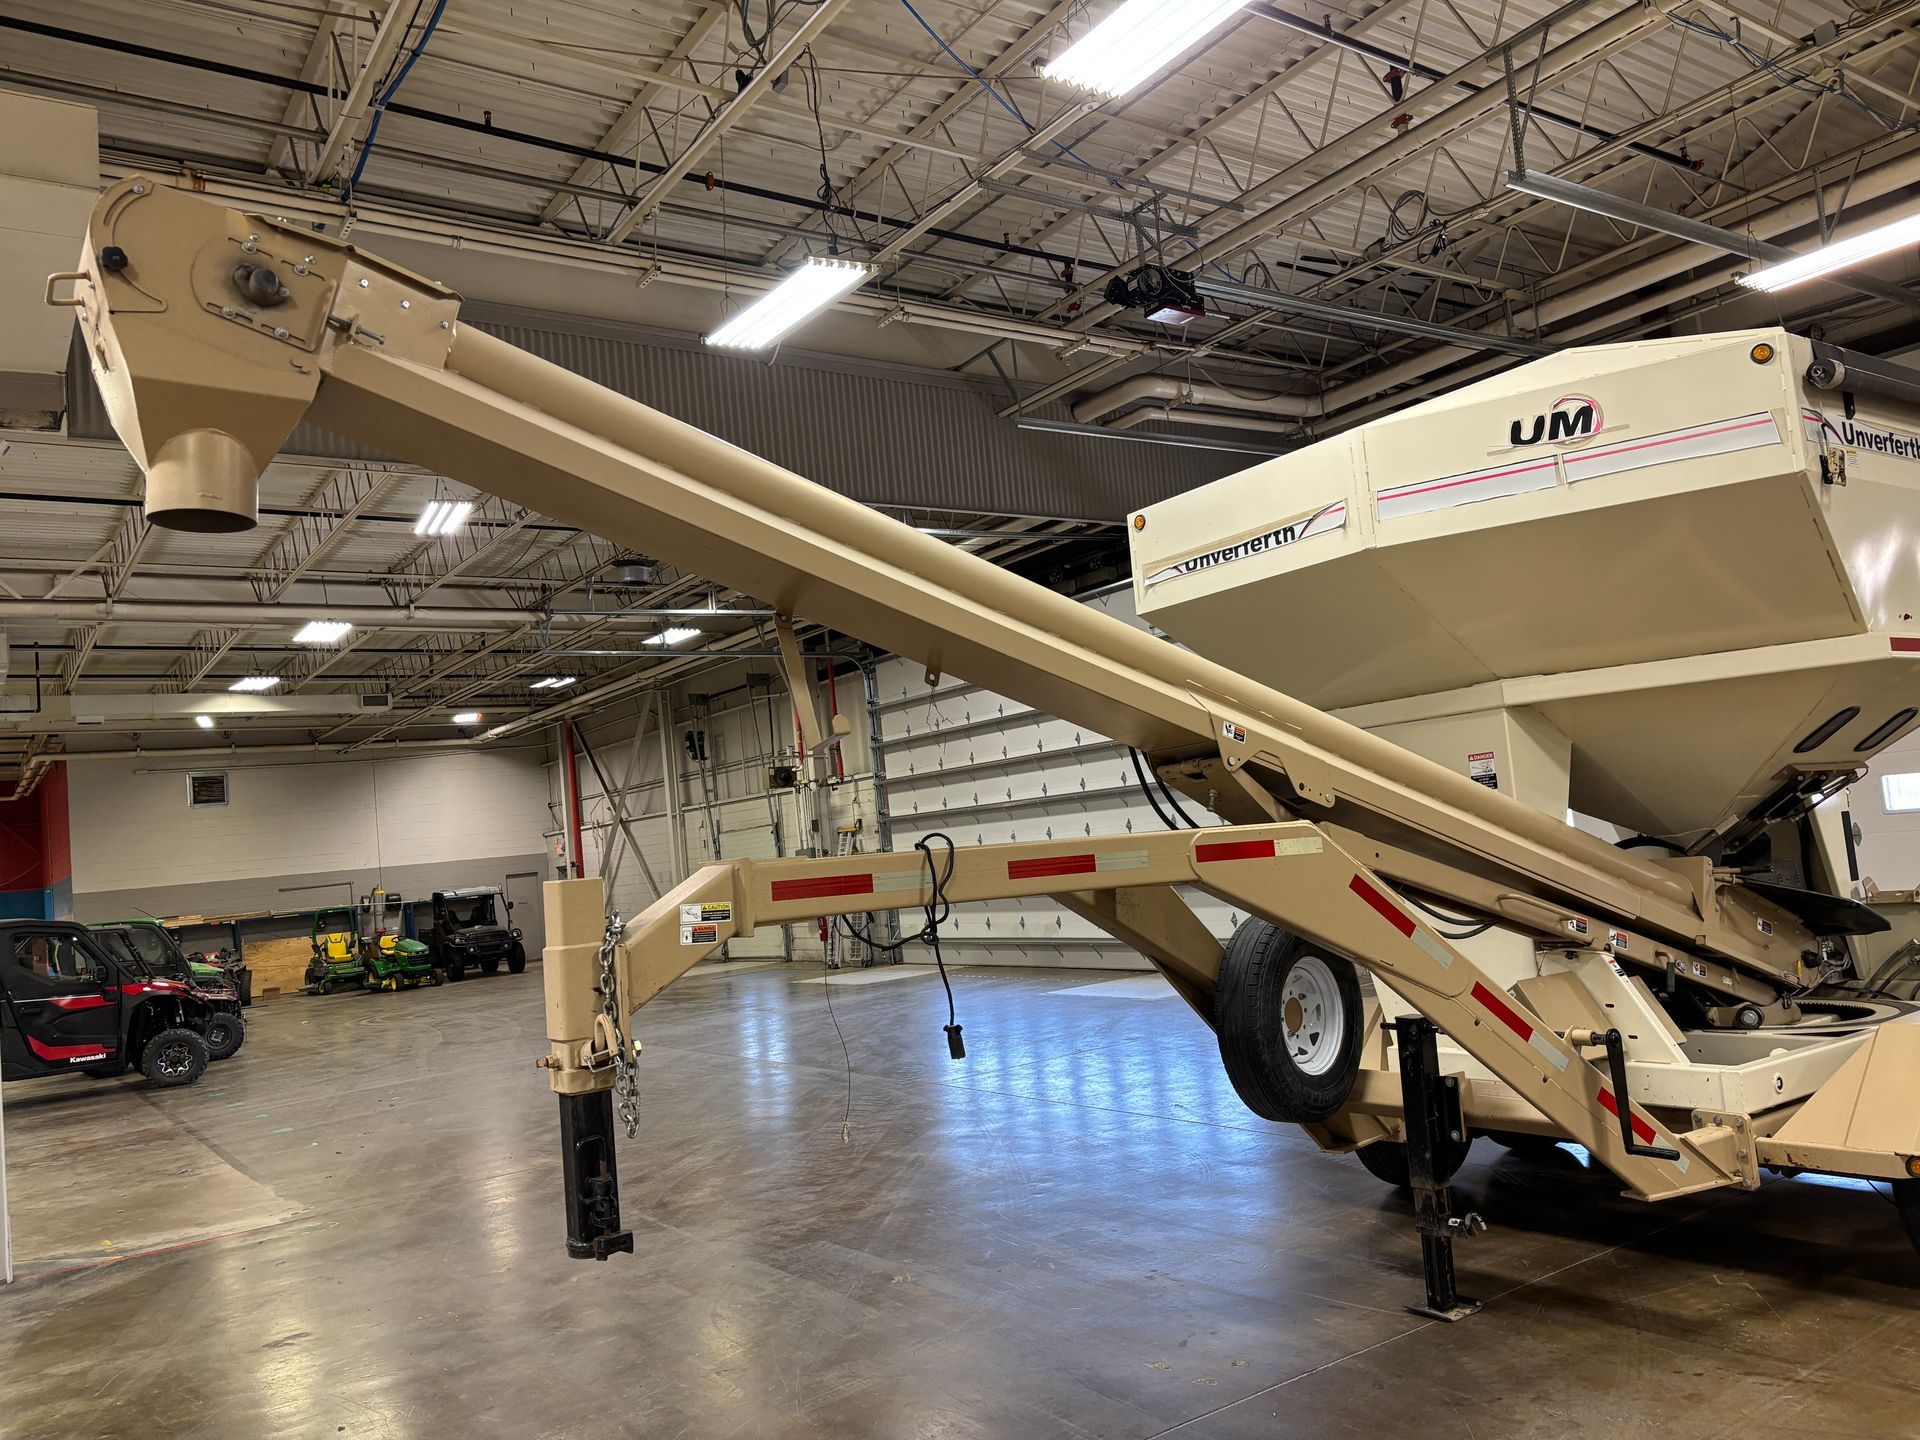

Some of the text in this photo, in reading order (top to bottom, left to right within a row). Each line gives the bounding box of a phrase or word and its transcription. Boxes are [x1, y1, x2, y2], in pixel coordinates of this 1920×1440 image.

[1510, 405, 1593, 445] UM
[1473, 752, 1493, 760] DANGER
[70, 1052, 106, 1063] Kawasaki
